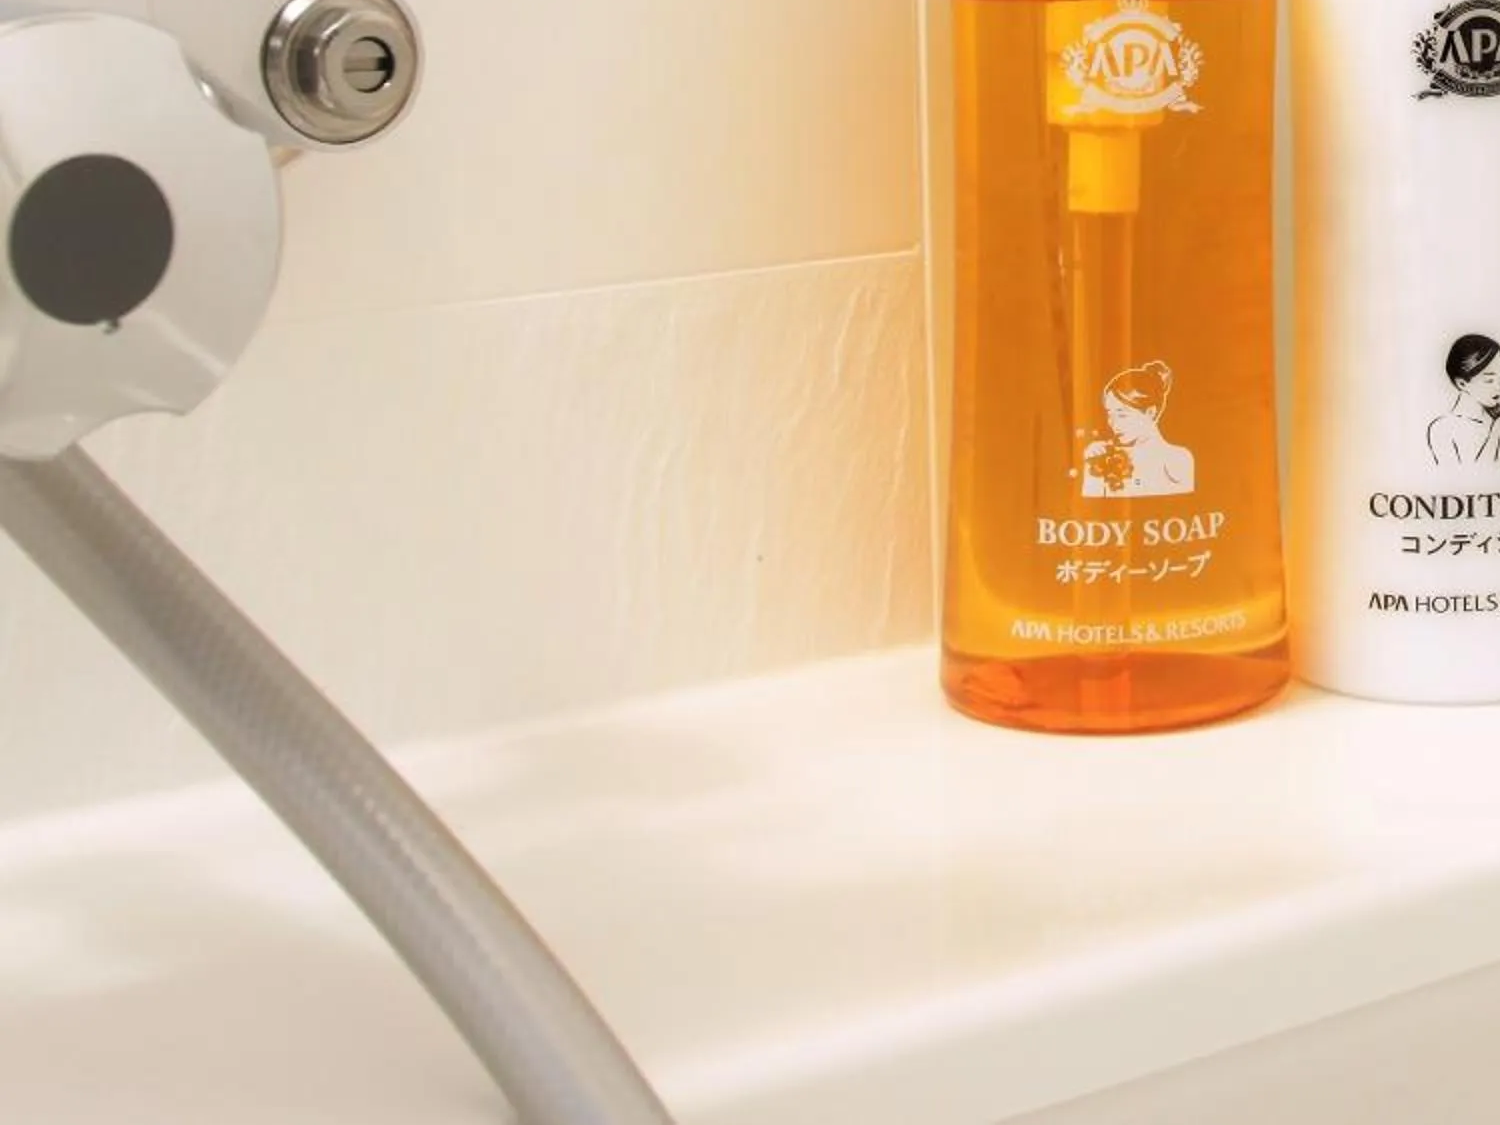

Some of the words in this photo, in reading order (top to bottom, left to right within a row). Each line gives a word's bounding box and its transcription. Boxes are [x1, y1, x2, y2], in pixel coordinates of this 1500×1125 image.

[1088, 41, 1179, 78] APA
[1036, 516, 1134, 547] BODY
[1142, 511, 1226, 546] SOAP
[1055, 550, 1213, 584] ボディーソープ
[1368, 592, 1410, 613] APA
[1011, 618, 1052, 642] APA
